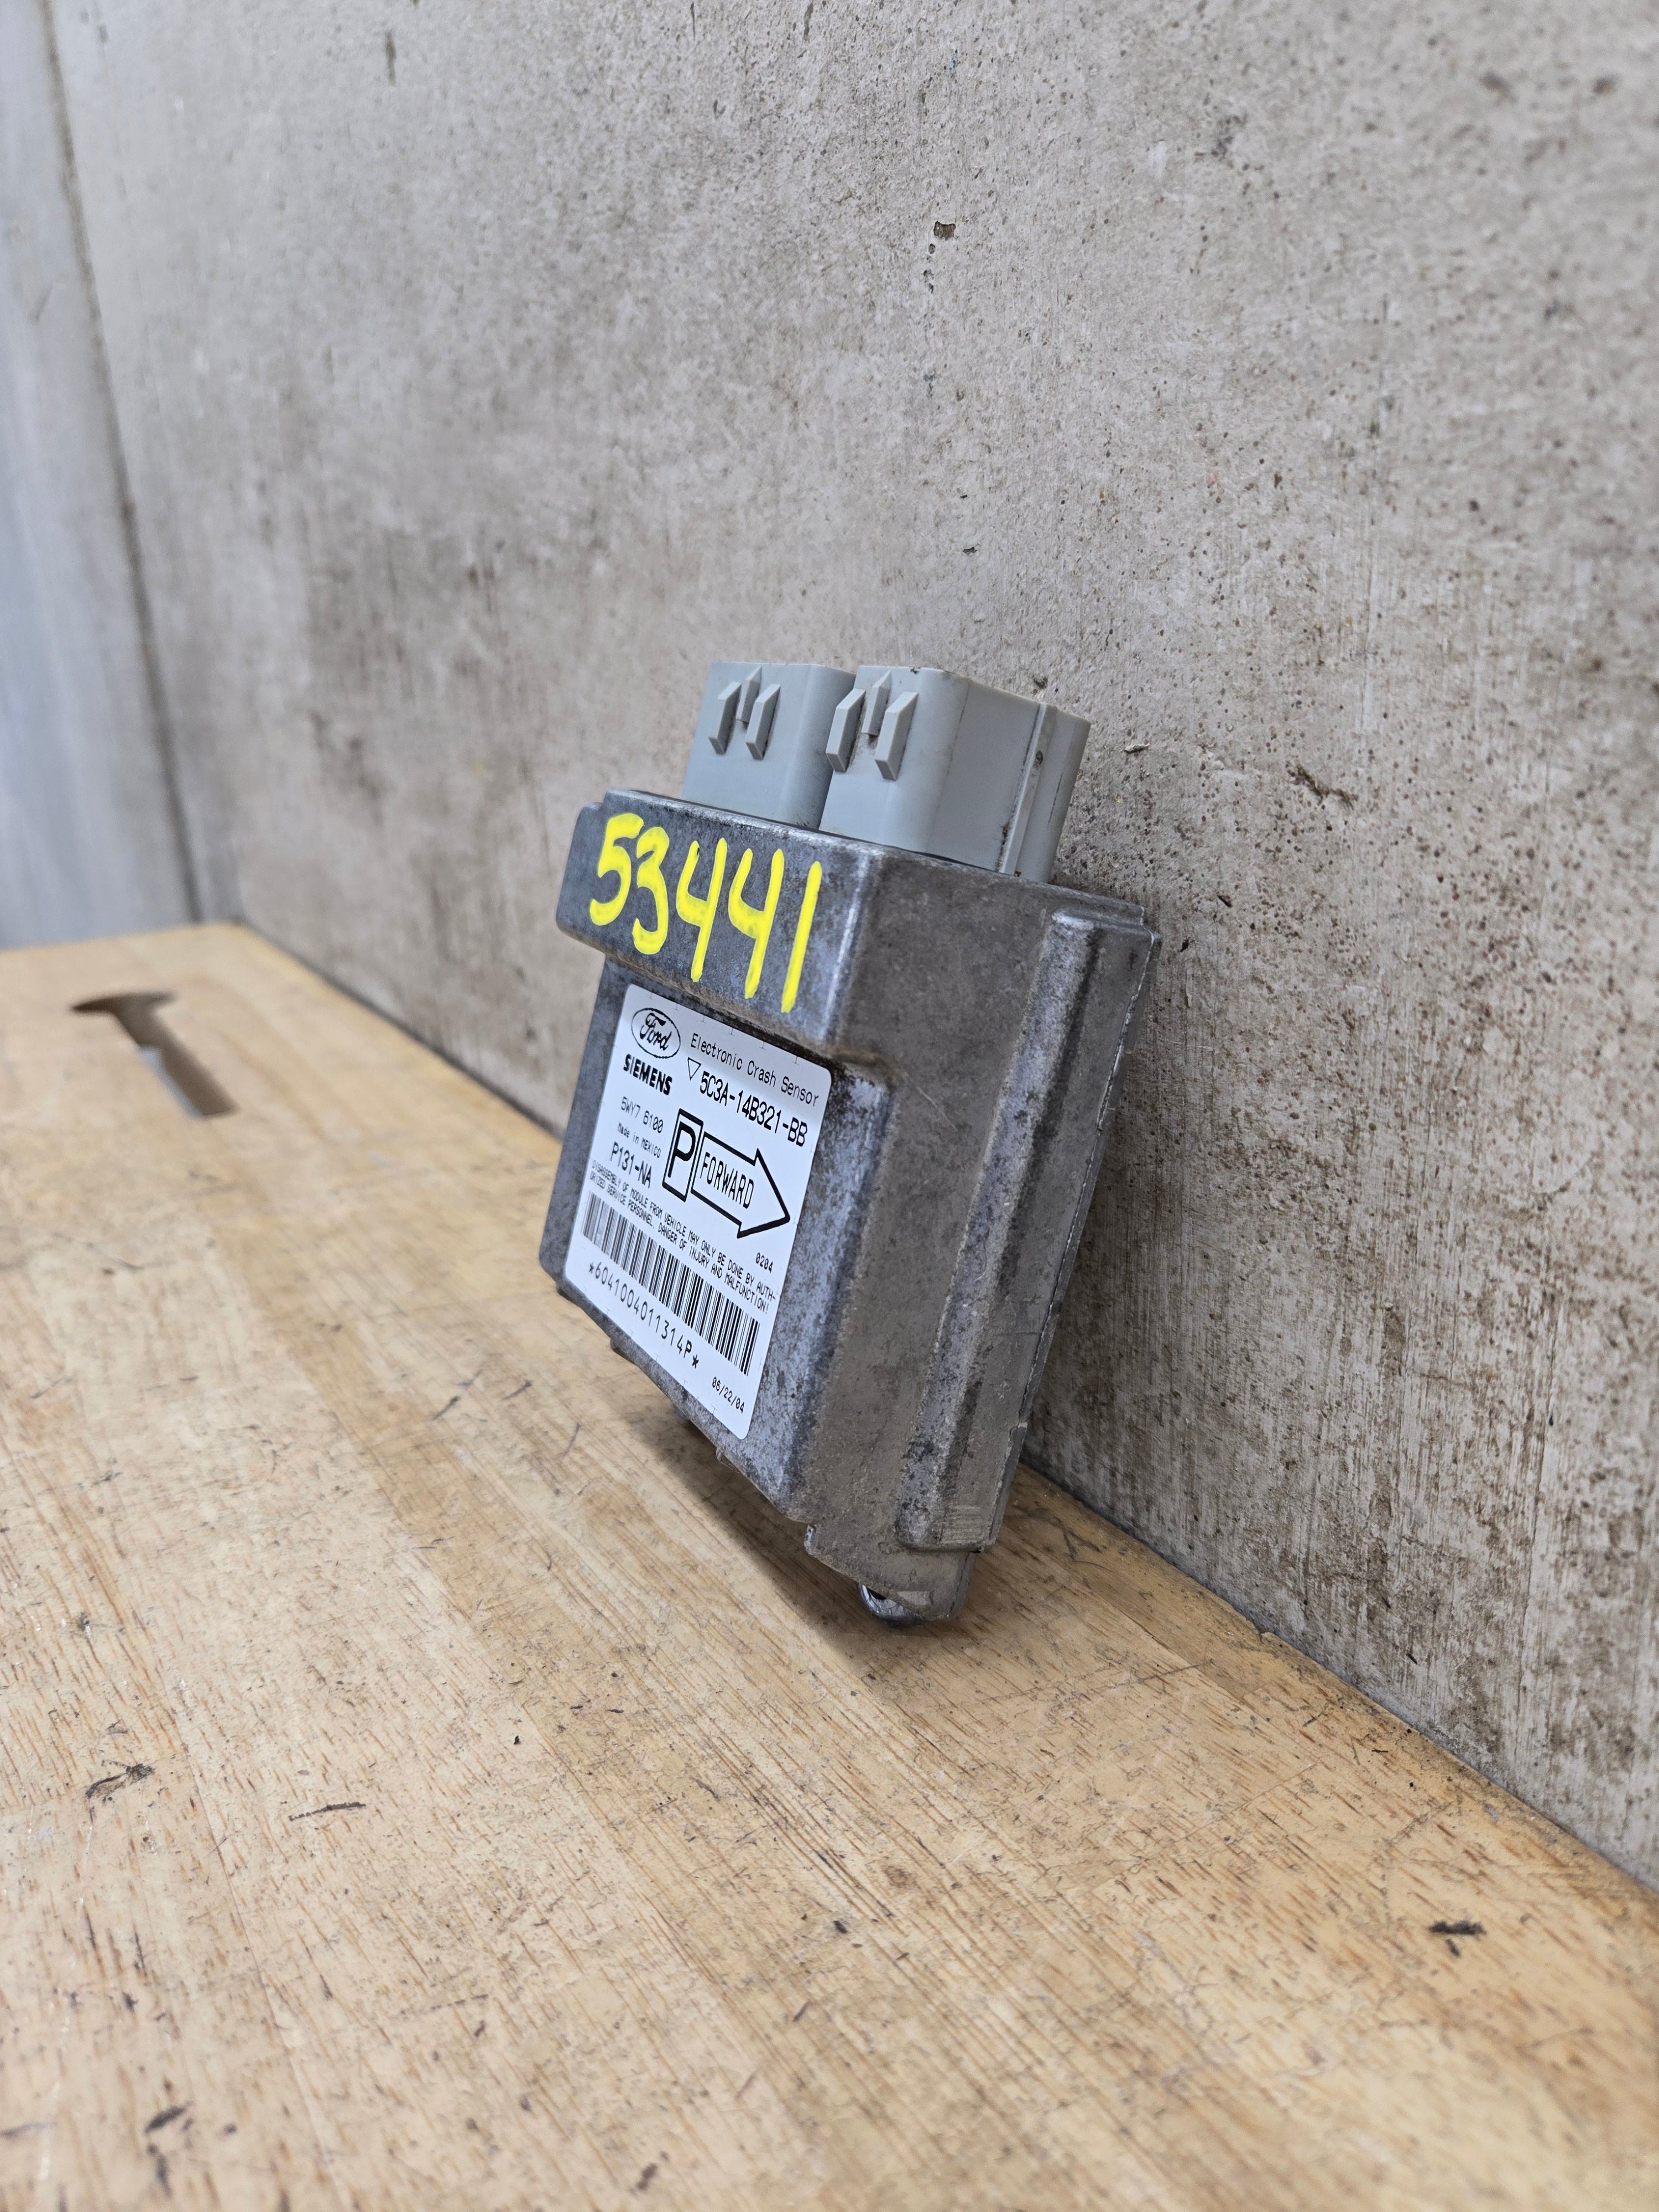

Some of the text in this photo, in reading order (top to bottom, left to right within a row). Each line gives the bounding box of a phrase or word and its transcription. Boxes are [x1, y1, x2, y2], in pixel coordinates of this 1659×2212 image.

[589, 813, 822, 1013] 53441
[639, 1013, 672, 1051] Ford
[623, 1054, 672, 1095] SIEMENS
[691, 1033, 819, 1107] Electronic Crash Sensor
[621, 1096, 664, 1134] 5WY7 6100
[700, 1071, 808, 1147] 5C3A-14B321-BB
[611, 1141, 653, 1188] P131-NA
[618, 1123, 661, 1159] Made in MEXICO
[667, 1121, 696, 1178] P
[700, 1152, 754, 1209] FORWARD
[592, 1160, 776, 1302] DISASSEMBLY OF MODULE FROM VEHICLE MAY ONLY BE DONE BY AUTH-
[607, 1184, 627, 1206] SERVICE
[658, 1222, 677, 1245] DANGER
[679, 1238, 687, 1251] OF
[689, 1246, 710, 1269] INJURY
[711, 1263, 723, 1279] AND
[724, 1272, 769, 1314] MALFUNCTION!
[755, 1252, 774, 1274] 0204
[712, 1376, 745, 1414] 06/22/04
